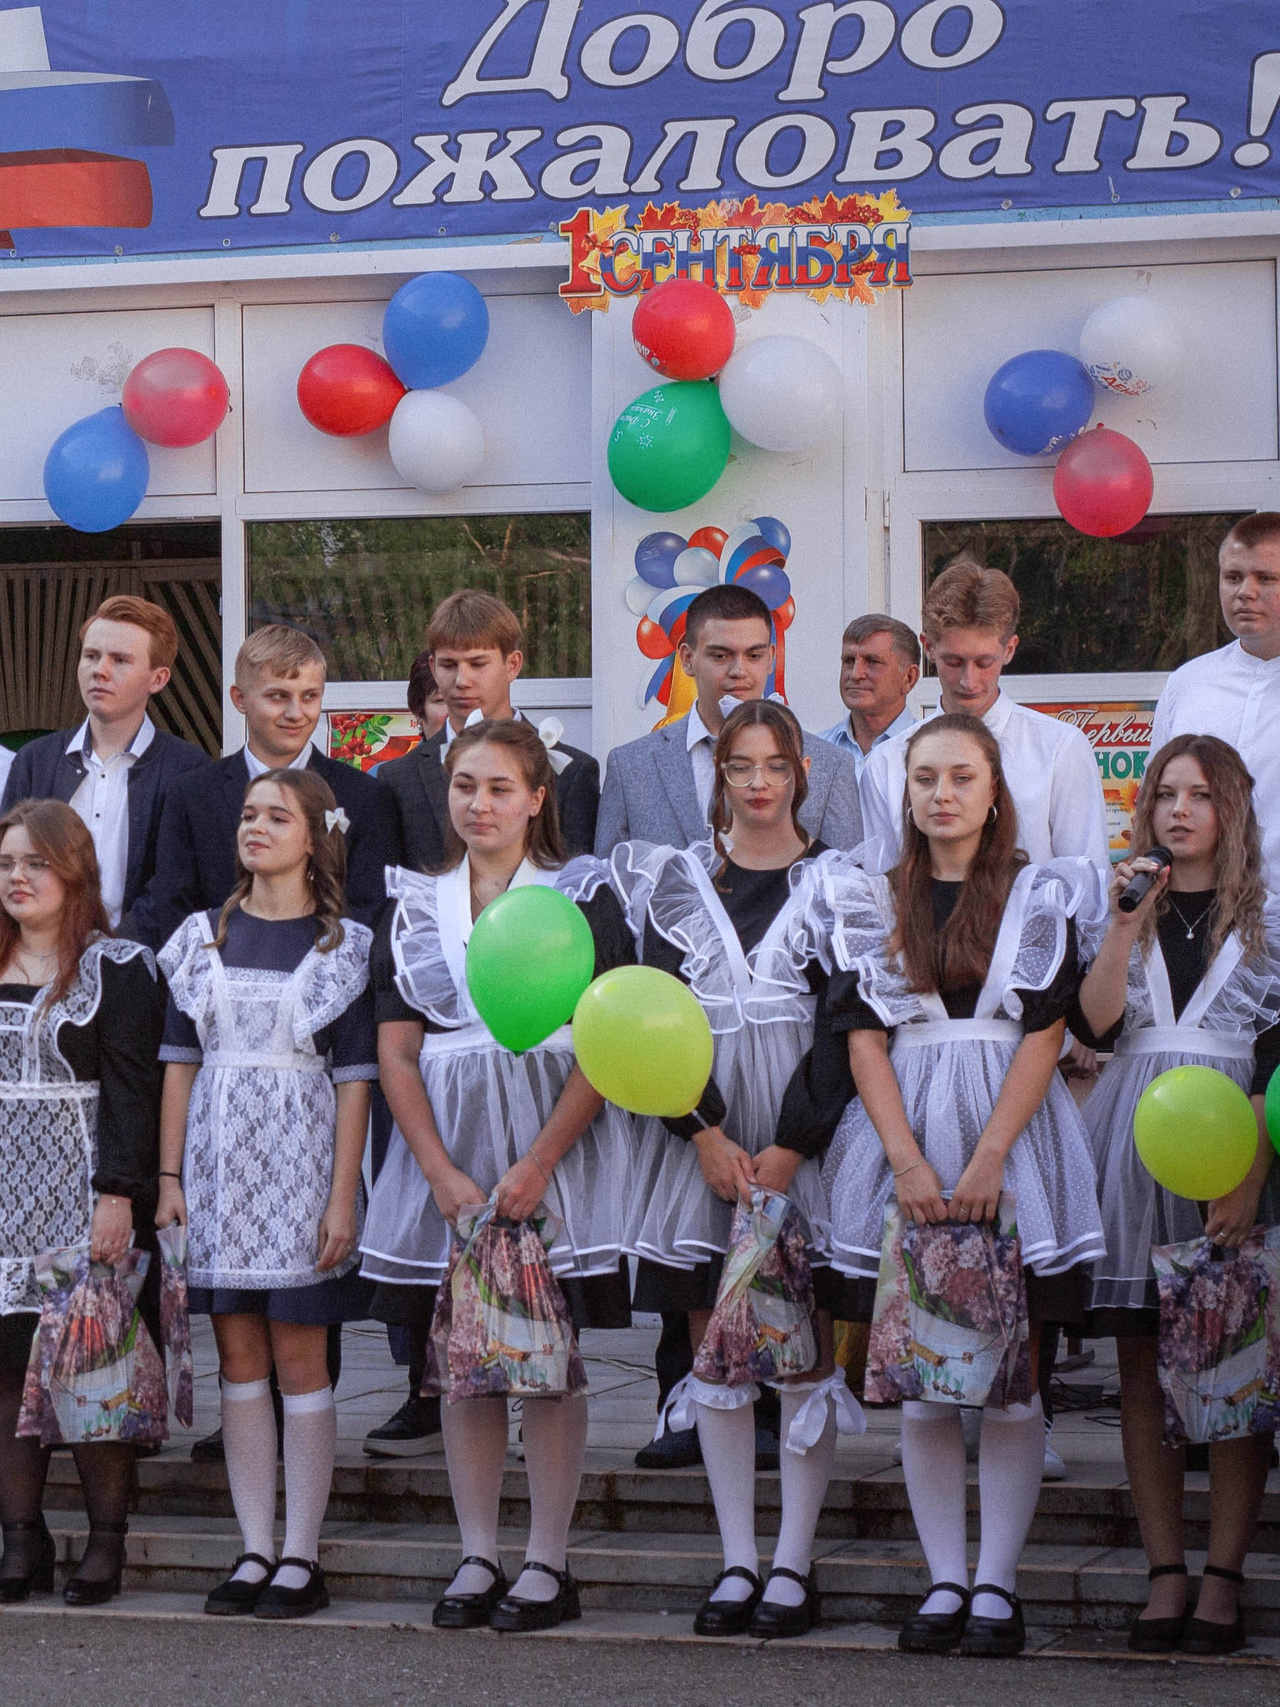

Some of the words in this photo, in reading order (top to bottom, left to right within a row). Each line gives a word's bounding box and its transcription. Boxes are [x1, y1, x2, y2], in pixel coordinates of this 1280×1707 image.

[439, 0, 1006, 107] Добро
[198, 51, 1280, 218] пожаловать!
[559, 206, 604, 298] 1
[598, 221, 914, 297] СЕНТЯБРЯ
[1093, 750, 1150, 779] НОК
